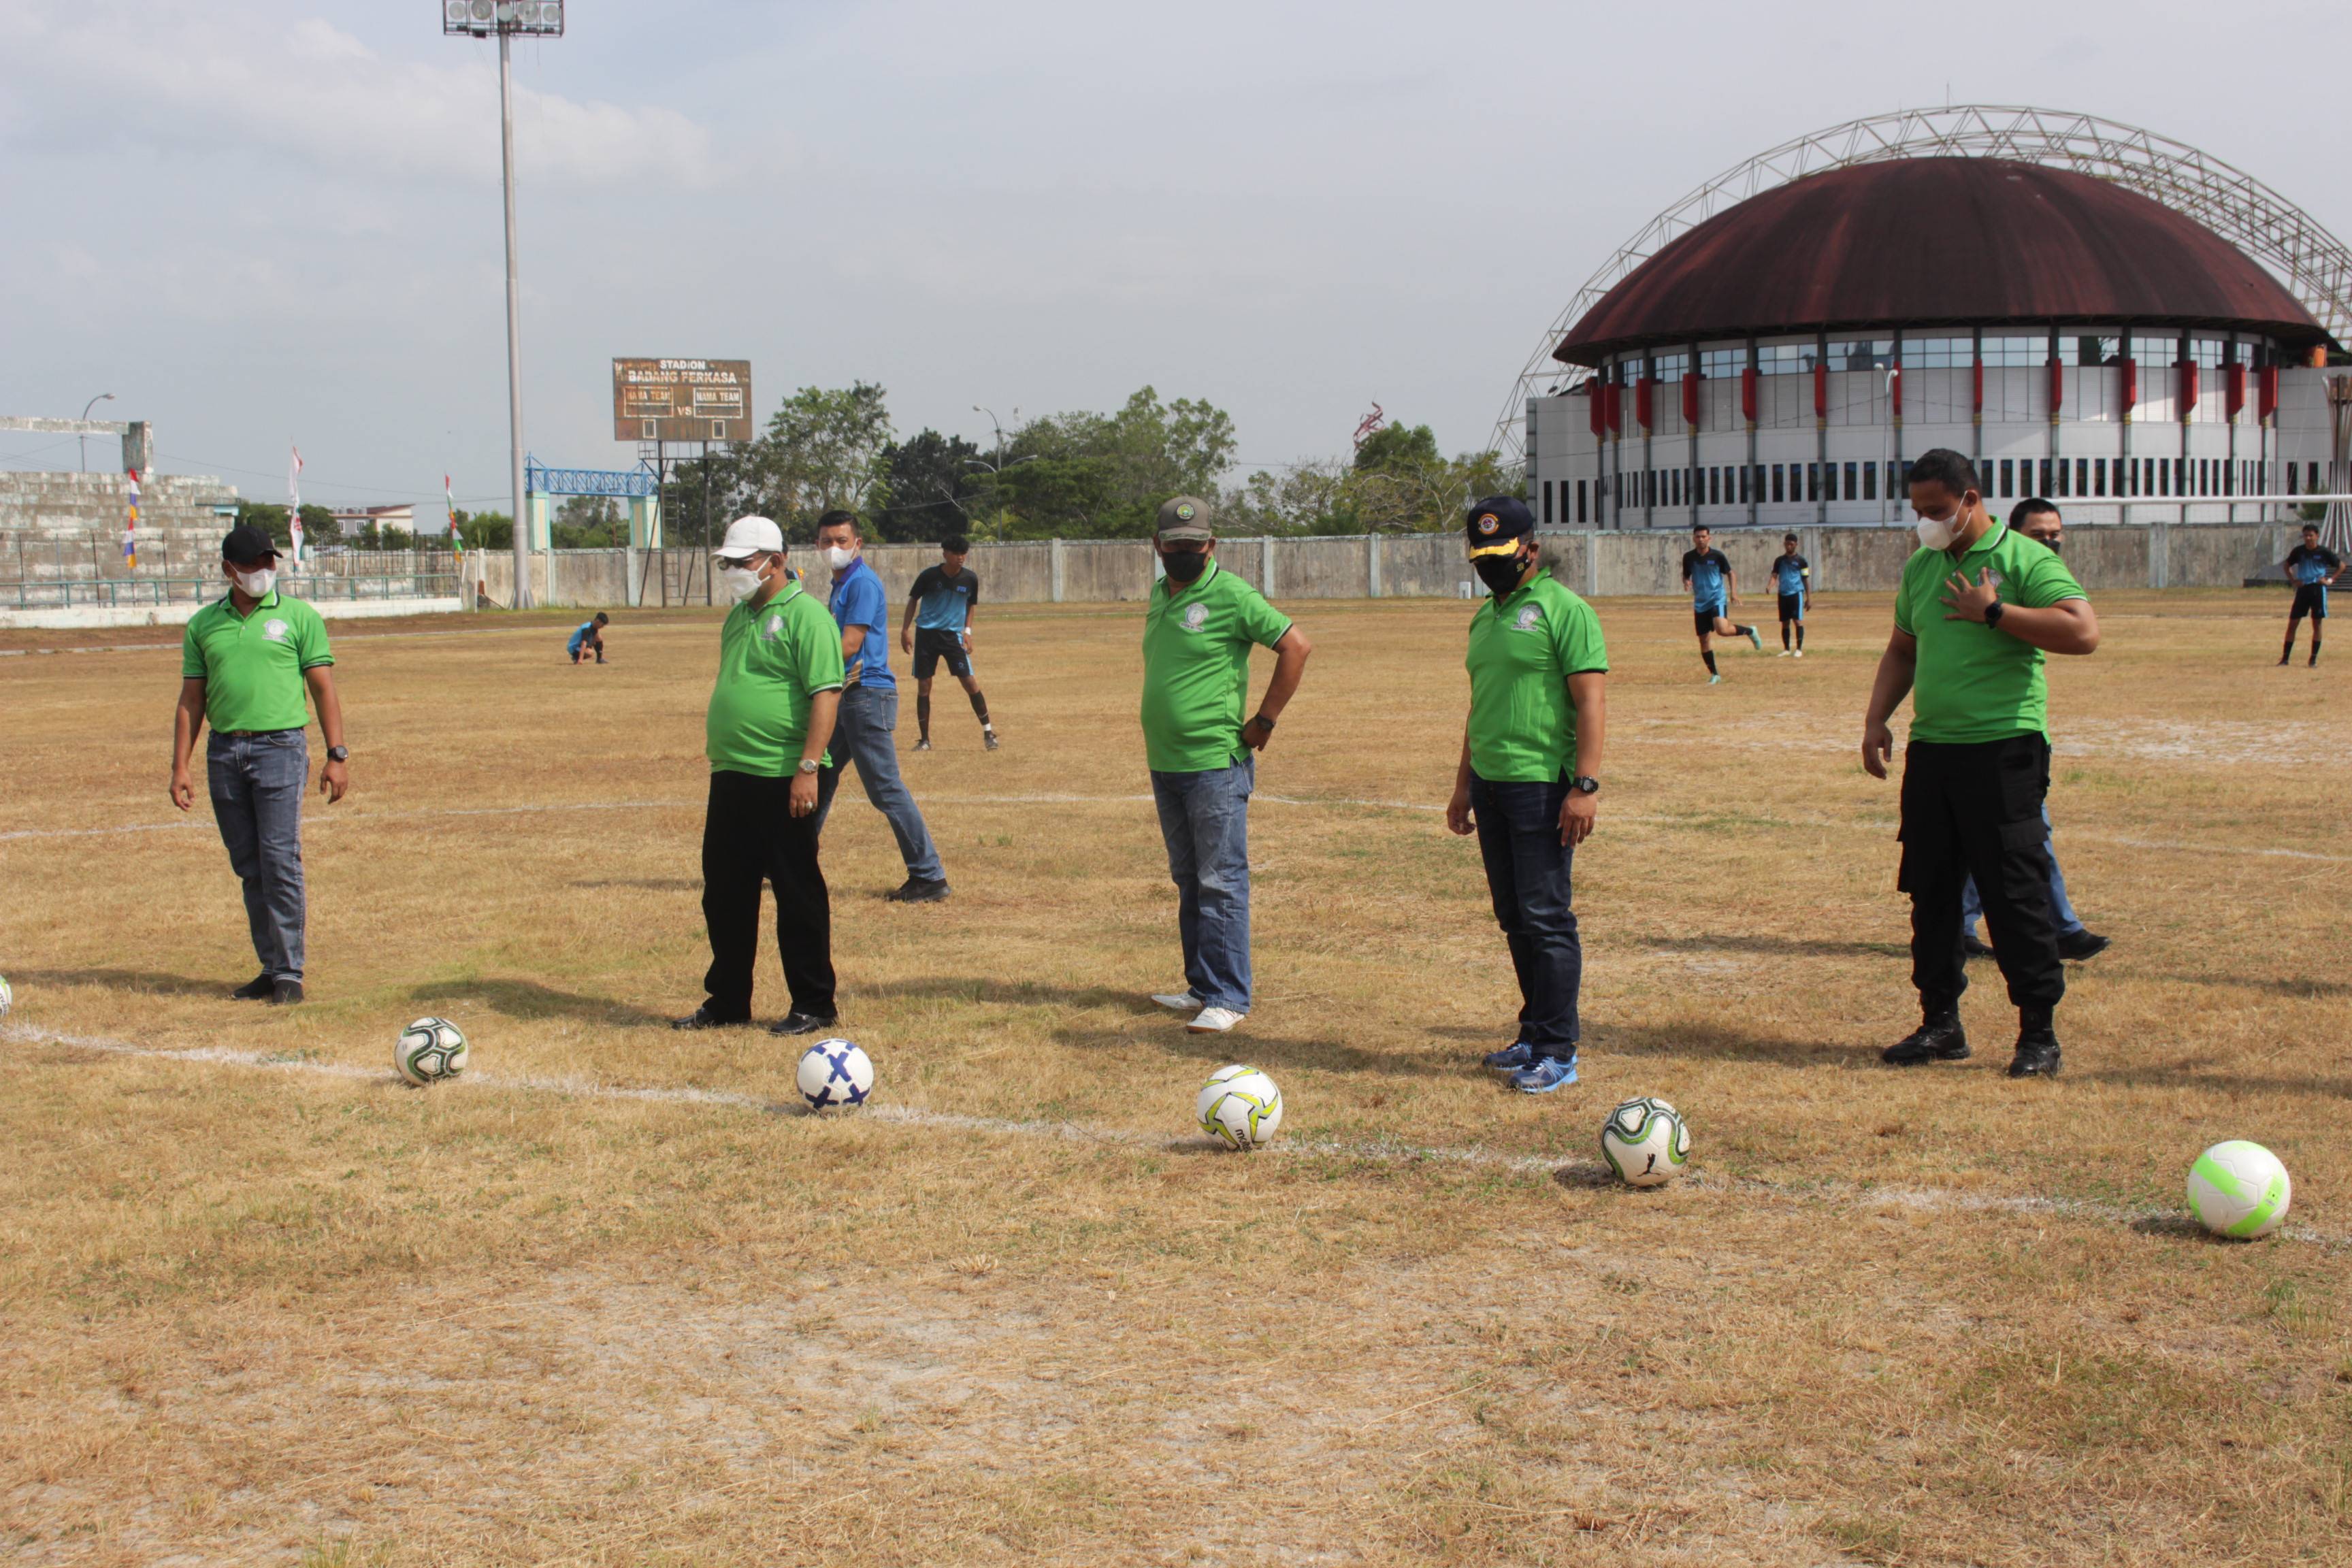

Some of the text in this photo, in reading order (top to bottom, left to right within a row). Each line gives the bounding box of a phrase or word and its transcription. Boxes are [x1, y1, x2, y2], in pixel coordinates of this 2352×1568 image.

[659, 359, 706, 370] STADION
[628, 370, 737, 384] BADANG PERKASA
[696, 391, 740, 402] NAMA TEAM
[677, 406, 692, 416] VS
